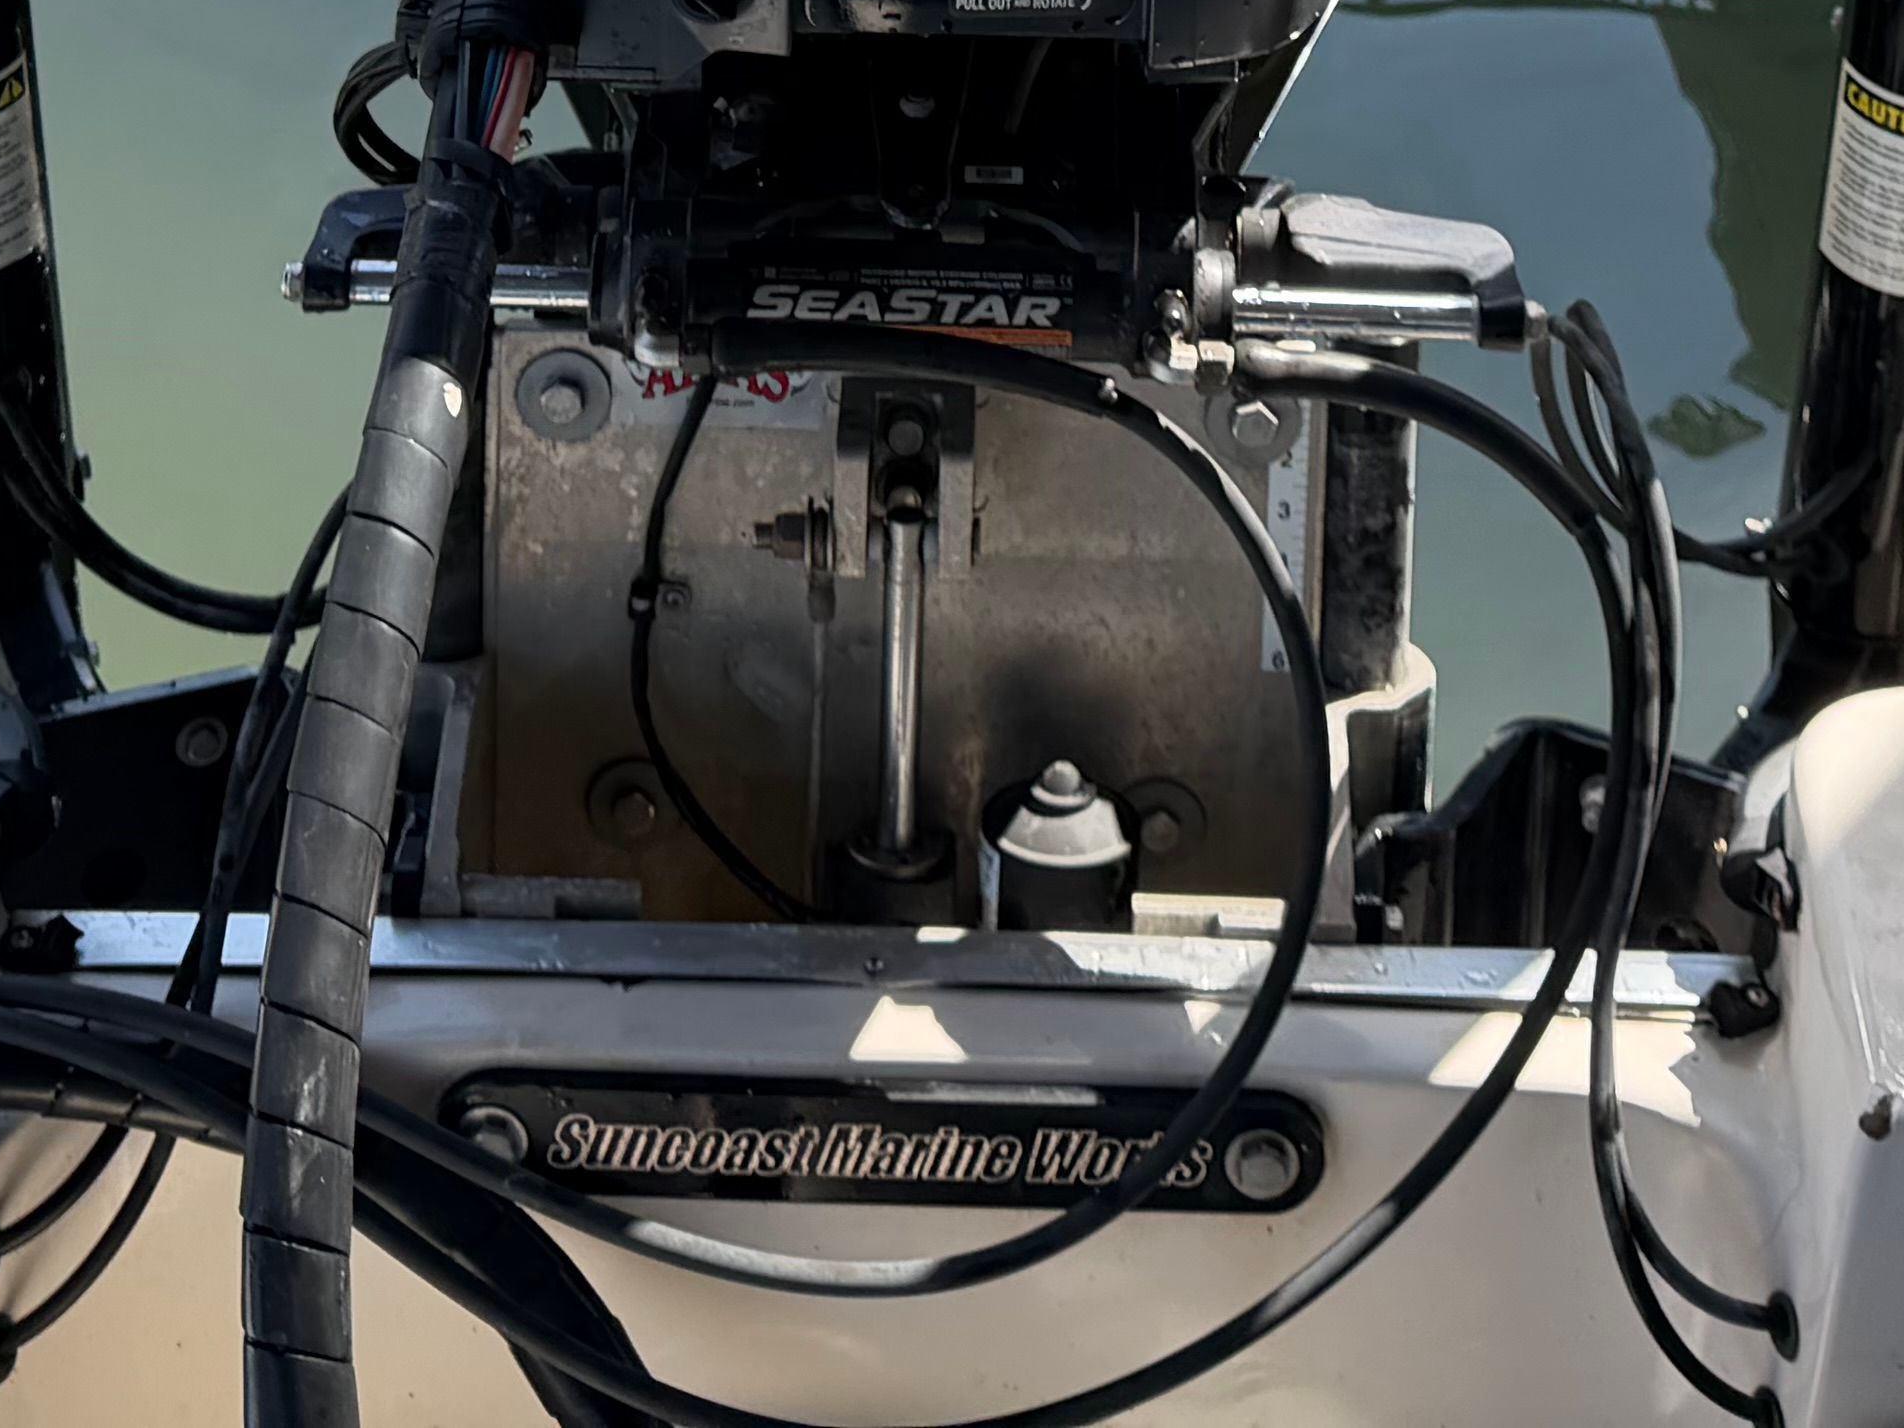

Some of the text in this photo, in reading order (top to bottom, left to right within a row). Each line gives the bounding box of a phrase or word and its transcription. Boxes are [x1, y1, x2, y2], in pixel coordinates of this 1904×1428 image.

[1277, 500, 1291, 520] 3
[546, 1112, 1214, 1190] Suncoast Marine Wors
